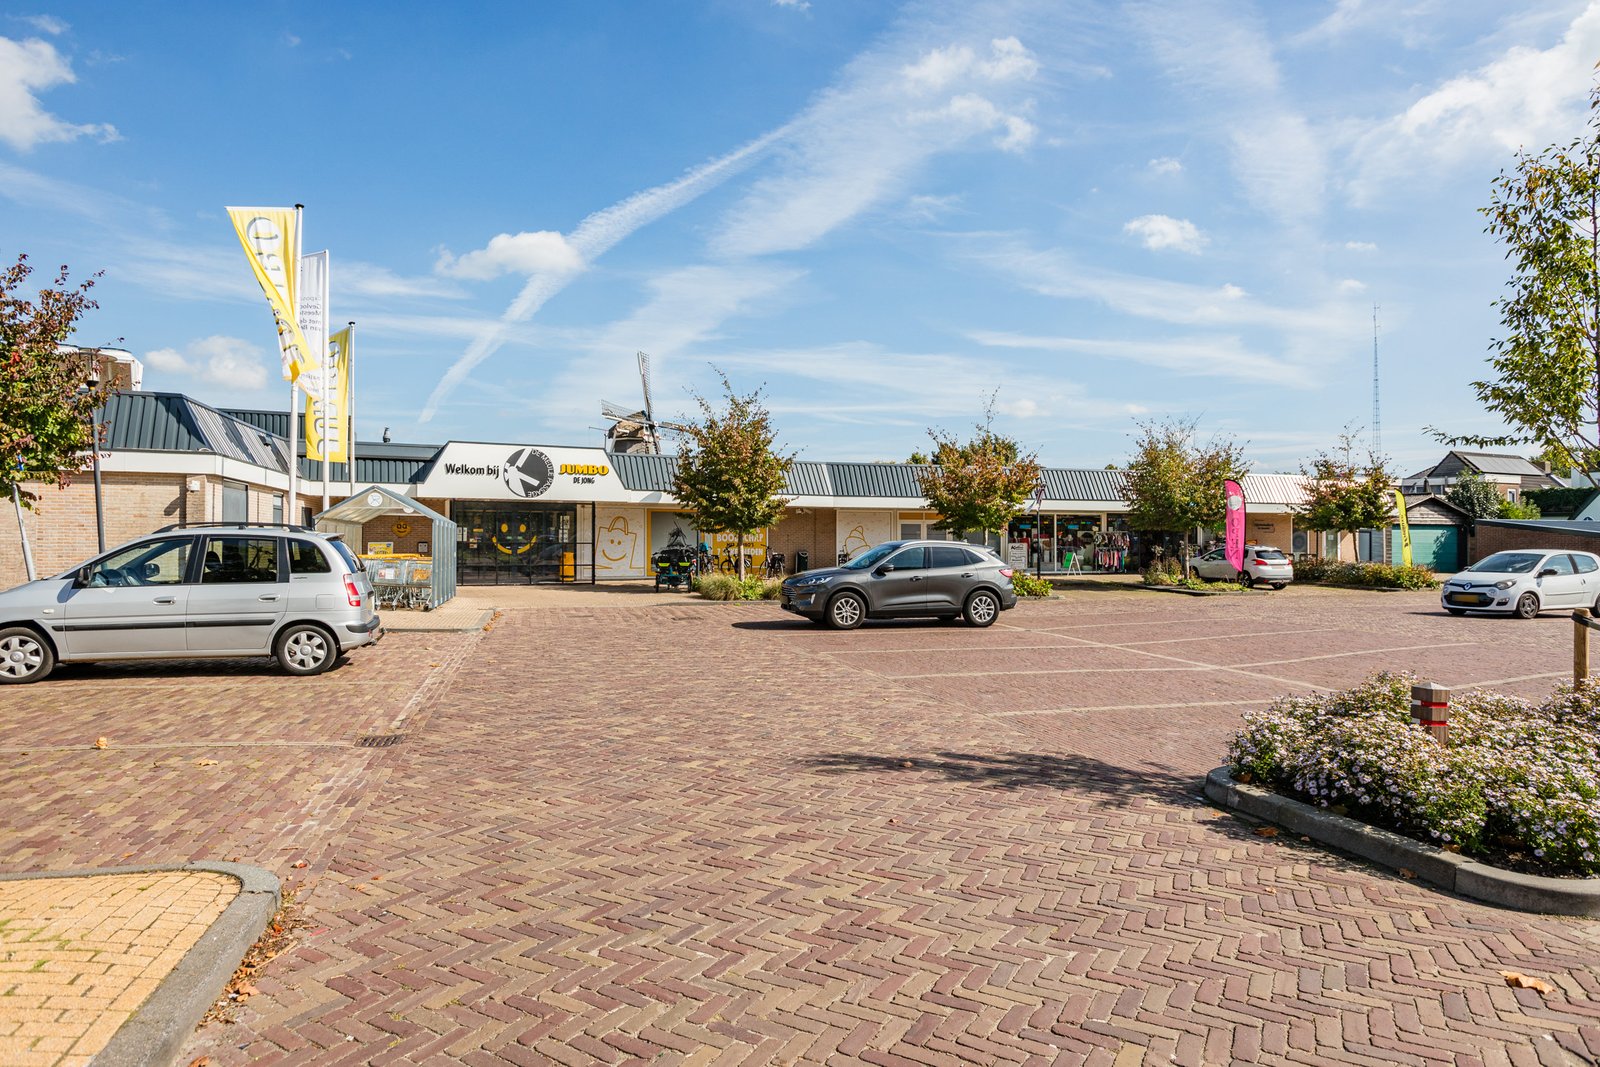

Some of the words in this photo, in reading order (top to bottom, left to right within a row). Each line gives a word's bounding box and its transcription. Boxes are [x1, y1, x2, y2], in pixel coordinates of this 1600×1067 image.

[531, 449, 541, 458] DE
[540, 454, 554, 477] MEULE
[559, 463, 609, 476] JUMBO
[445, 463, 485, 475] Welkom
[486, 464, 500, 480] bij
[573, 476, 581, 484] DE
[581, 477, 595, 485] JONG
